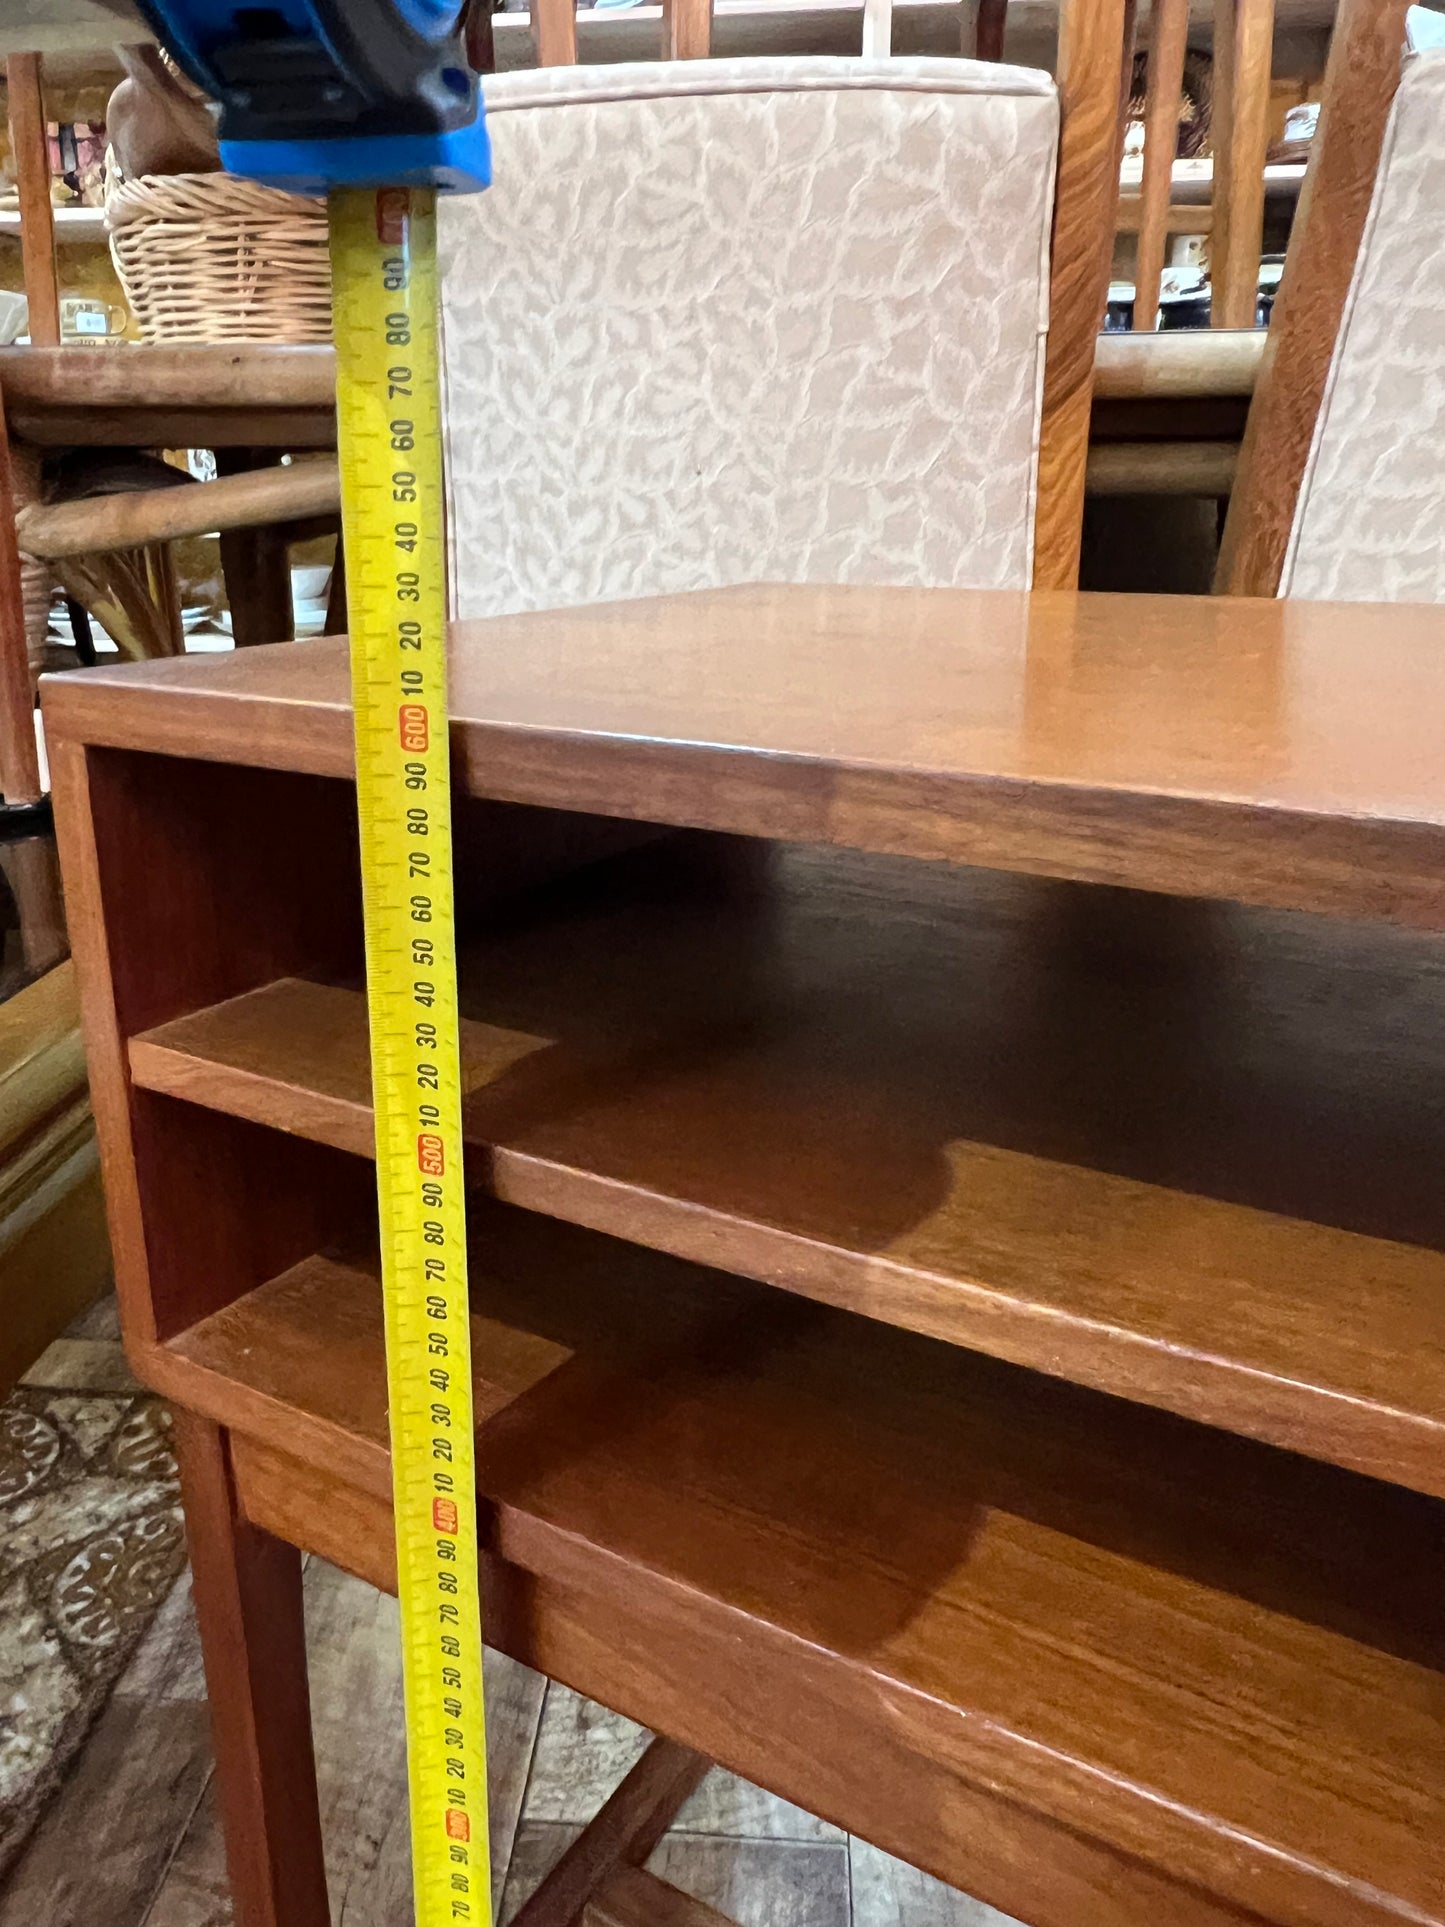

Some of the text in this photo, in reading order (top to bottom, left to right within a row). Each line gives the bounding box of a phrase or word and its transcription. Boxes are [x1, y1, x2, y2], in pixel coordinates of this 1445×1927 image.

[385, 312, 411, 346] 80
[387, 366, 412, 400] 70
[390, 419, 414, 451] 60
[392, 471, 416, 503] 50
[395, 522, 418, 552] 40
[396, 572, 420, 602] 30
[399, 621, 422, 650] 20
[401, 670, 423, 695] 10
[404, 707, 426, 751] 600
[405, 762, 427, 790] 90
[407, 808, 428, 836] 80
[409, 852, 431, 878] 70
[410, 895, 432, 923] 60
[412, 938, 433, 966] 50
[414, 981, 435, 1007] 40
[416, 1023, 437, 1049] 30
[417, 1064, 439, 1090] 20
[419, 1105, 440, 1126] 10
[422, 1136, 442, 1175] 500
[422, 1183, 443, 1208] 90
[424, 1221, 444, 1245] 80
[425, 1259, 445, 1282] 70
[427, 1295, 447, 1320] 60
[428, 1332, 448, 1356] 50
[430, 1368, 450, 1392] 40
[431, 1403, 451, 1427] 30
[433, 1437, 452, 1462] 20
[434, 1473, 454, 1492] 10
[439, 1604, 458, 1625] 70
[442, 1667, 461, 1688] 50
[445, 1728, 464, 1749] 30
[446, 1758, 464, 1779] 20
[447, 1789, 466, 1806] 10
[452, 1900, 470, 1921] 70
